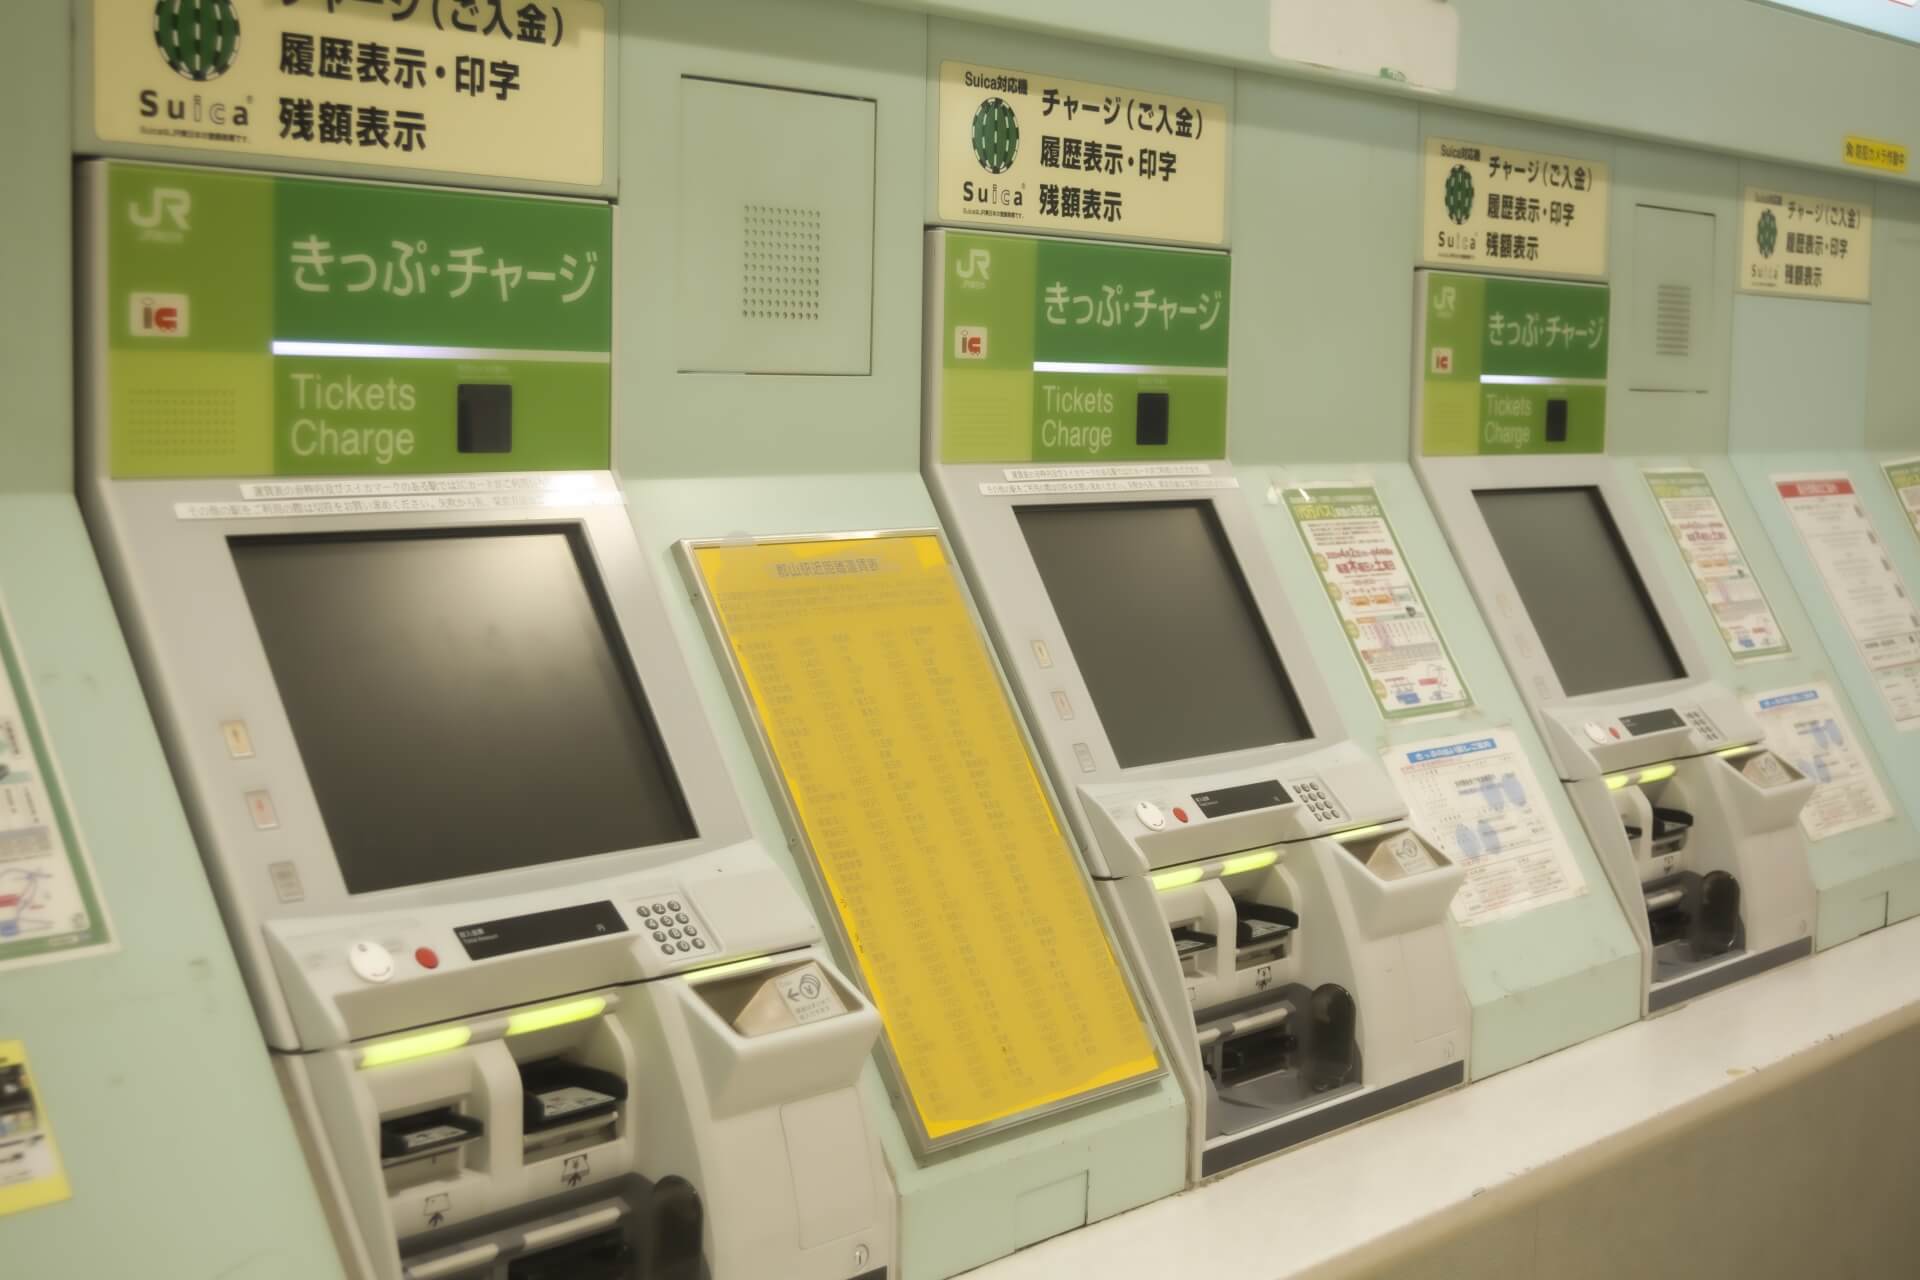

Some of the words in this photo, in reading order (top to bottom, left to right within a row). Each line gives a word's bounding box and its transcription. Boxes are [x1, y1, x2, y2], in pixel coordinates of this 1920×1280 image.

[279, 32, 520, 101] 履歴表示・印字
[139, 89, 249, 126] Suica
[278, 96, 427, 153] 残額表示
[1041, 87, 1204, 141] チャージ(ご入金)
[1040, 134, 1178, 183] 履歴表示・印字
[1488, 156, 1593, 192] チャージ(ご入金)
[128, 187, 191, 231] JR
[962, 180, 1024, 206] Suica
[1039, 183, 1123, 223] 残額表示
[1488, 193, 1575, 227] 履歴表示・印字
[1438, 231, 1476, 251] Suica
[1486, 232, 1539, 261] 残額表示
[289, 234, 597, 304] きっぷ・チャージ
[956, 248, 991, 281] JR
[1044, 281, 1221, 331] きっぷ・チャージ
[1433, 285, 1456, 311] JR
[289, 372, 417, 413] Tickets
[1042, 385, 1113, 414] Tickets
[1486, 393, 1532, 417] Tickets
[289, 418, 416, 465] Charge
[1041, 419, 1112, 454] Charge
[1484, 421, 1530, 448] Charge
